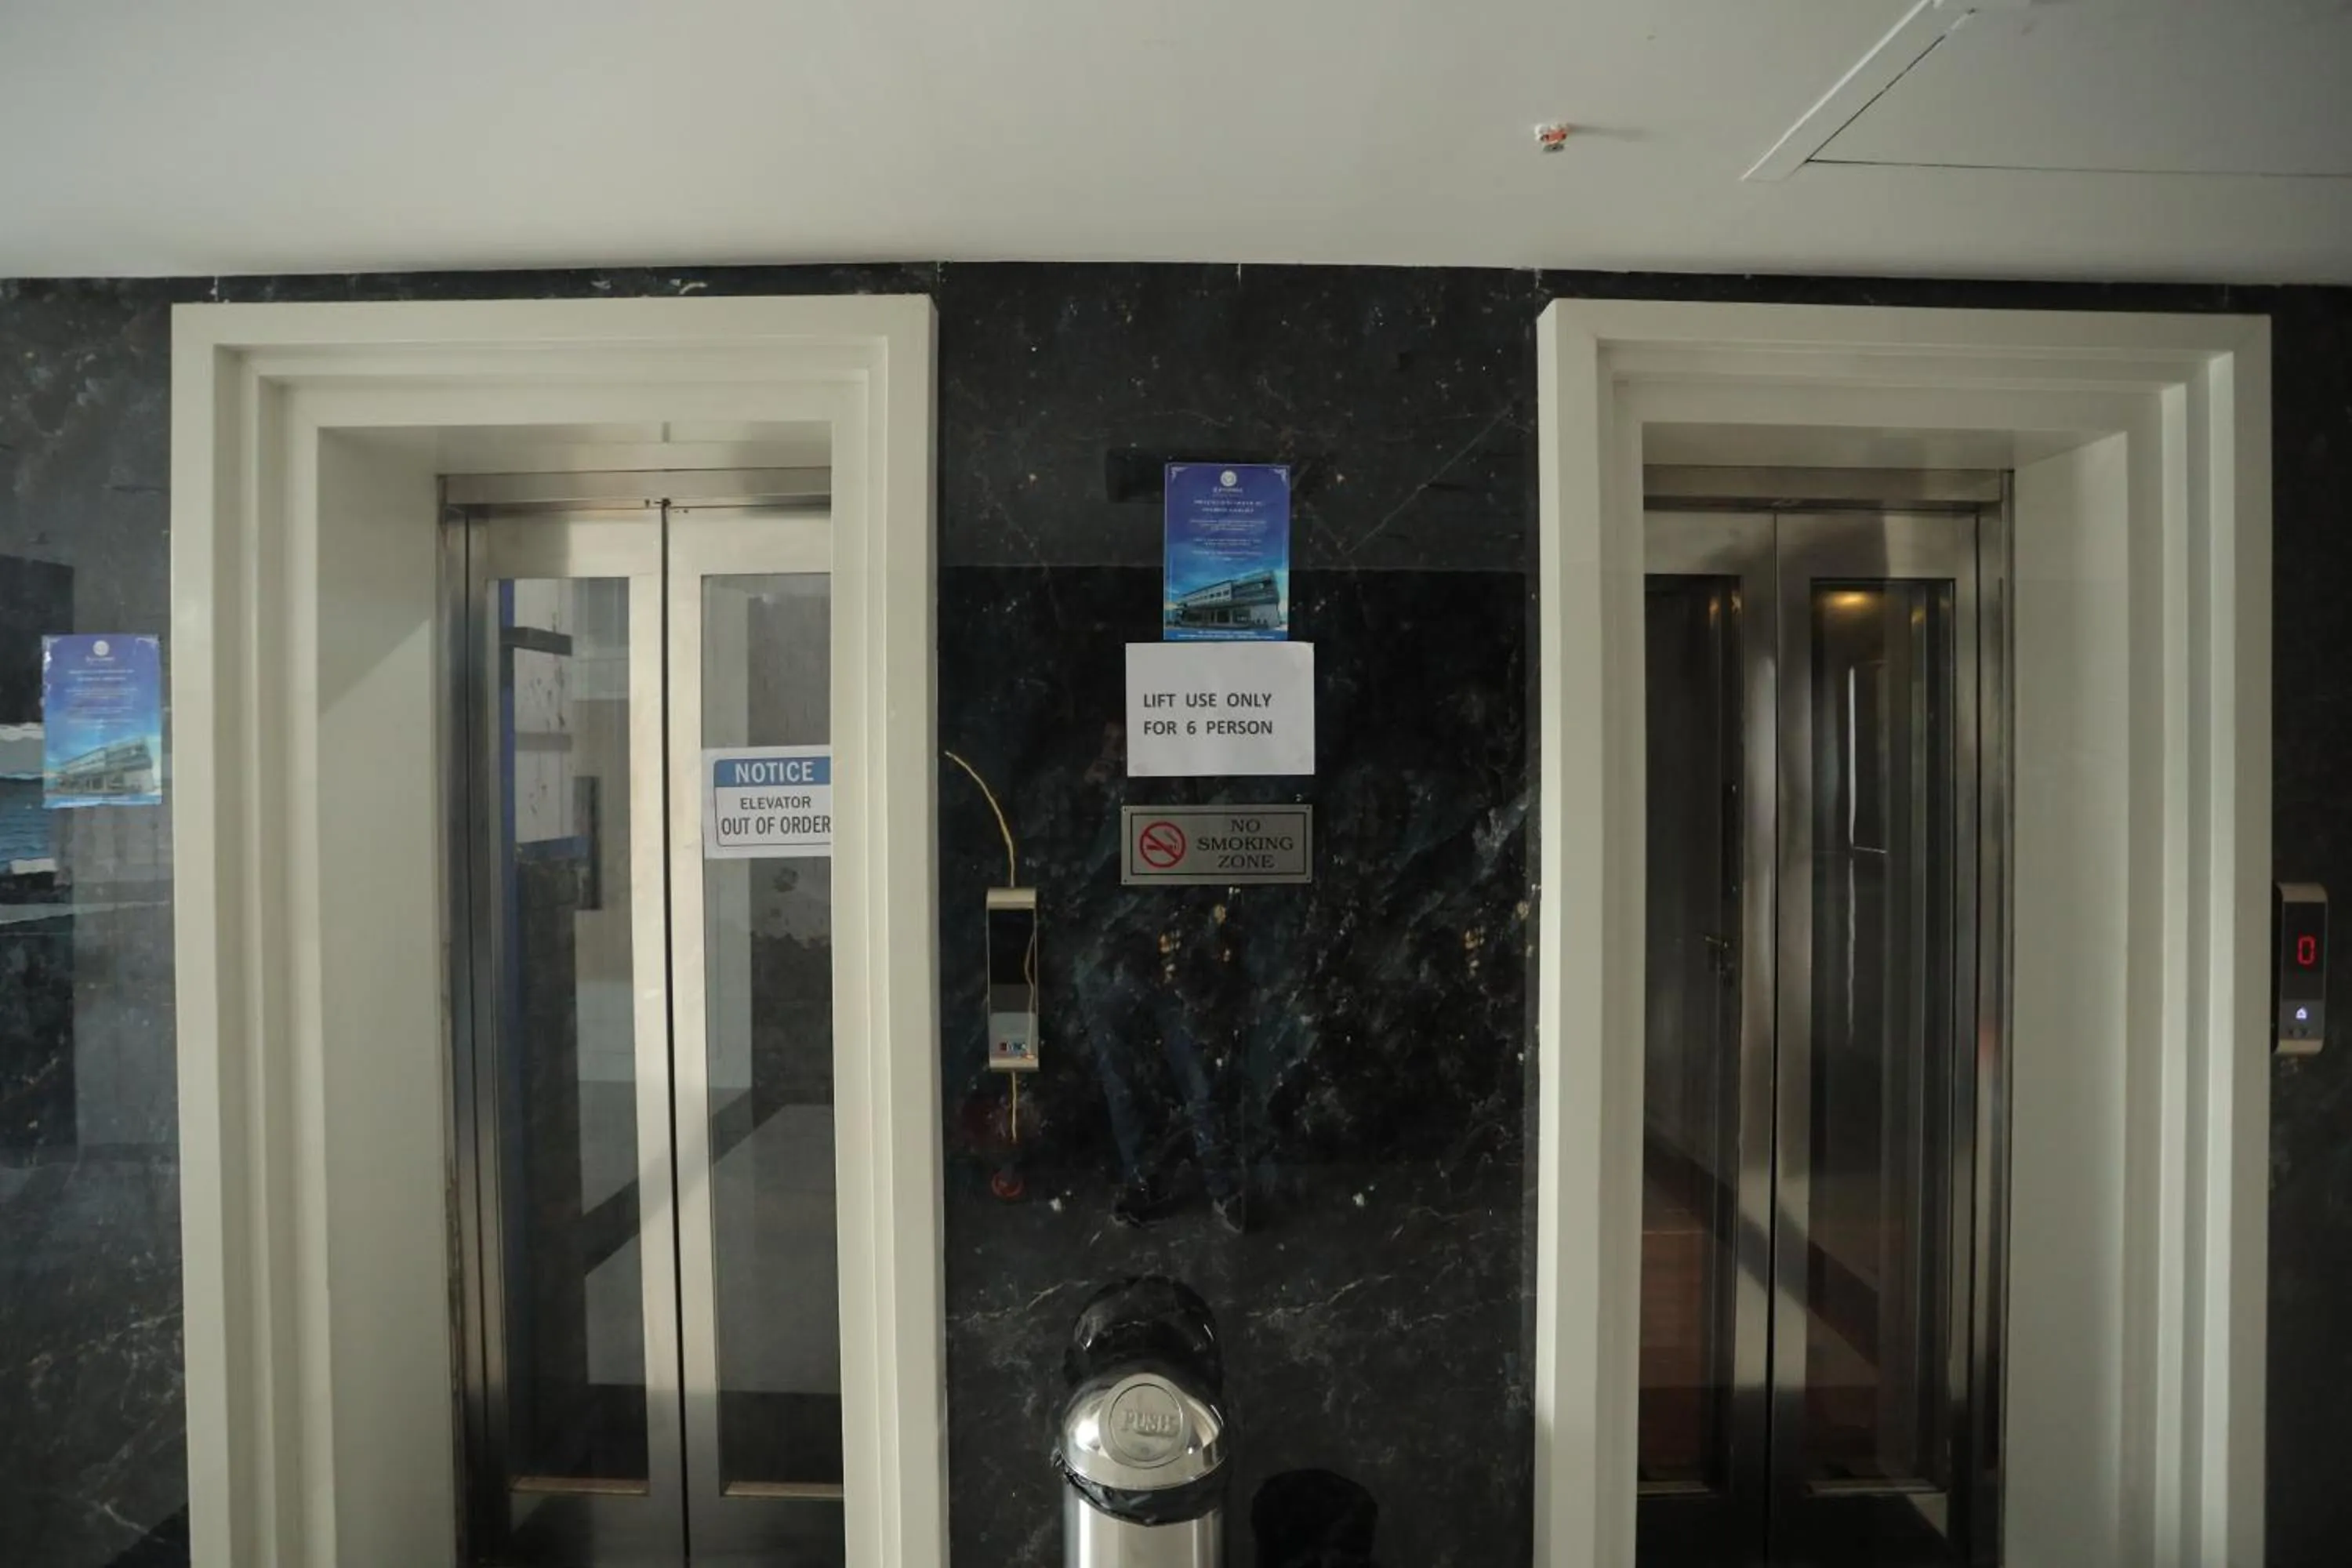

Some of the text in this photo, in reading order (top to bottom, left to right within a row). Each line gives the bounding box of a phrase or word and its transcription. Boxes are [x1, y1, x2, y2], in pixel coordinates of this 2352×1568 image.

[1144, 693, 1272, 707] LIFT USE ONLY
[1144, 720, 1272, 735] FOR 6 PERSON
[735, 761, 815, 783] NOTICE
[740, 796, 811, 810] ELEVATOR
[721, 815, 831, 836] OUT OF ORDER
[1231, 820, 1261, 833] NO
[1196, 837, 1293, 851] SMOKING
[1218, 855, 1275, 869] ZONE
[1120, 1409, 1178, 1436] PUSH
